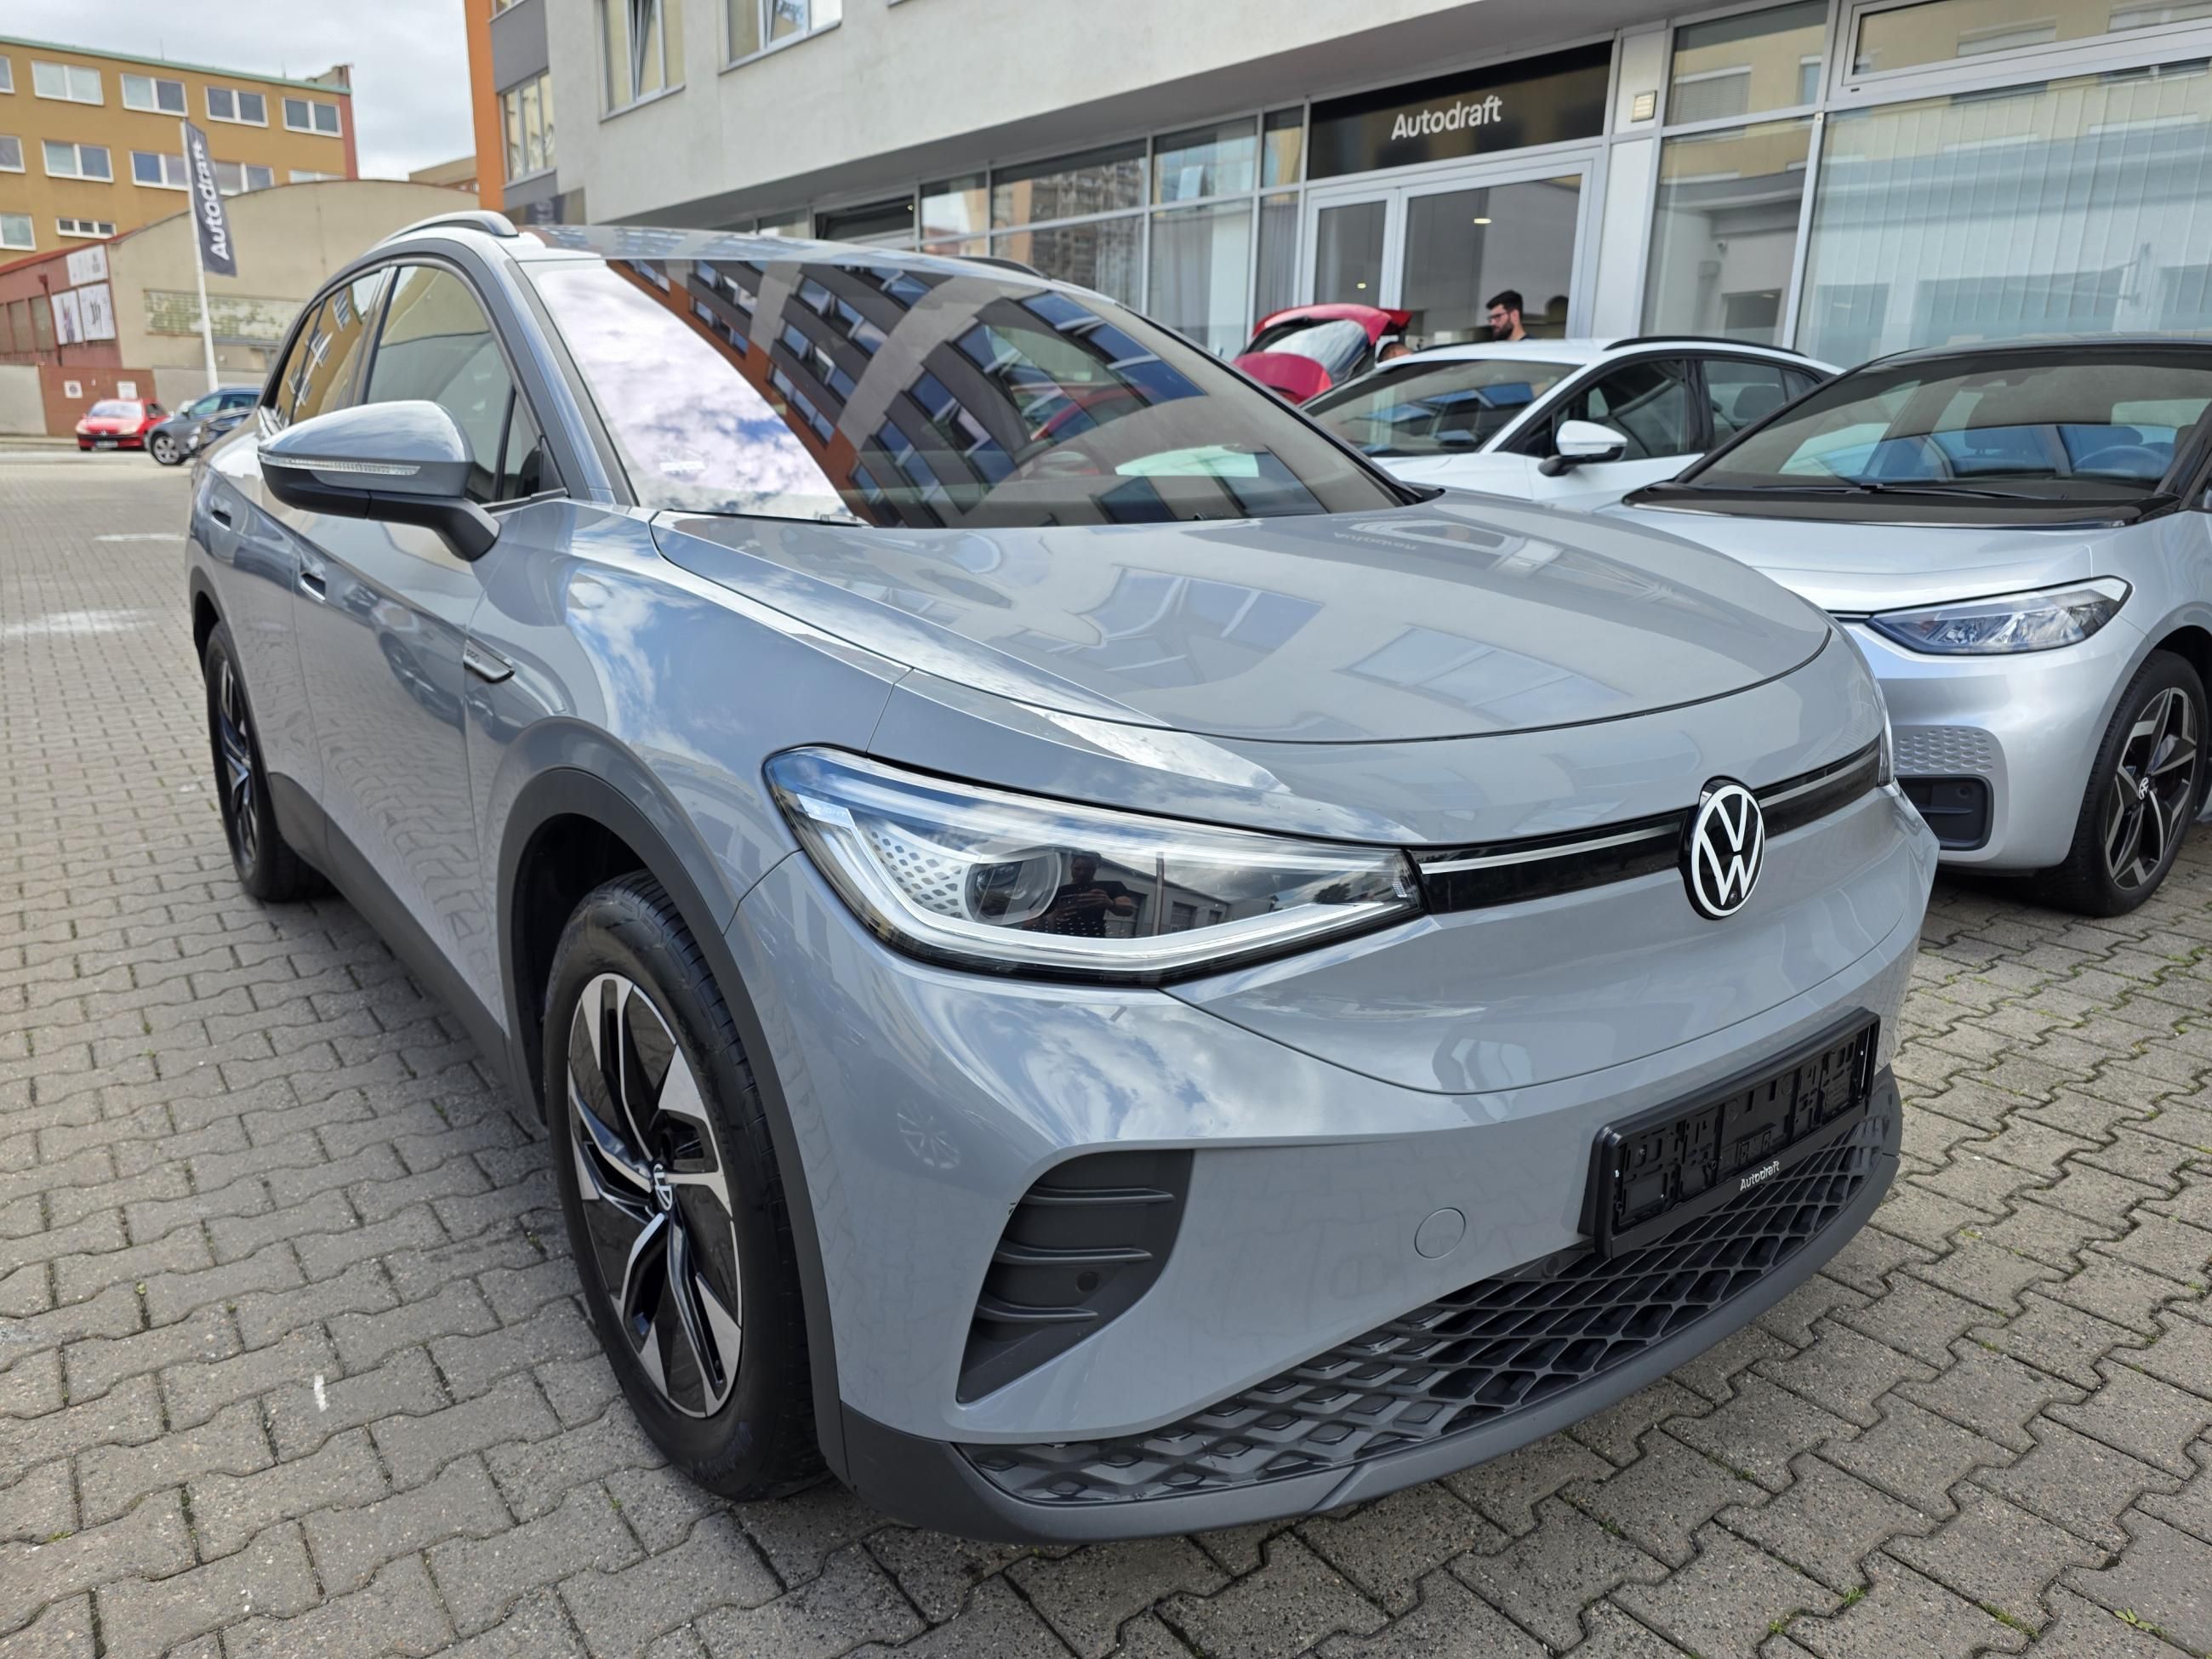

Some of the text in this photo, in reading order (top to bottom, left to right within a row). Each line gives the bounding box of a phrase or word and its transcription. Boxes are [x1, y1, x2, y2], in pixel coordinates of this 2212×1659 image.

[1391, 94, 1502, 140] Autodraft
[192, 139, 230, 260] Autodraft
[1698, 791, 1764, 908] VW
[1740, 1160, 1780, 1191] Autodraft
